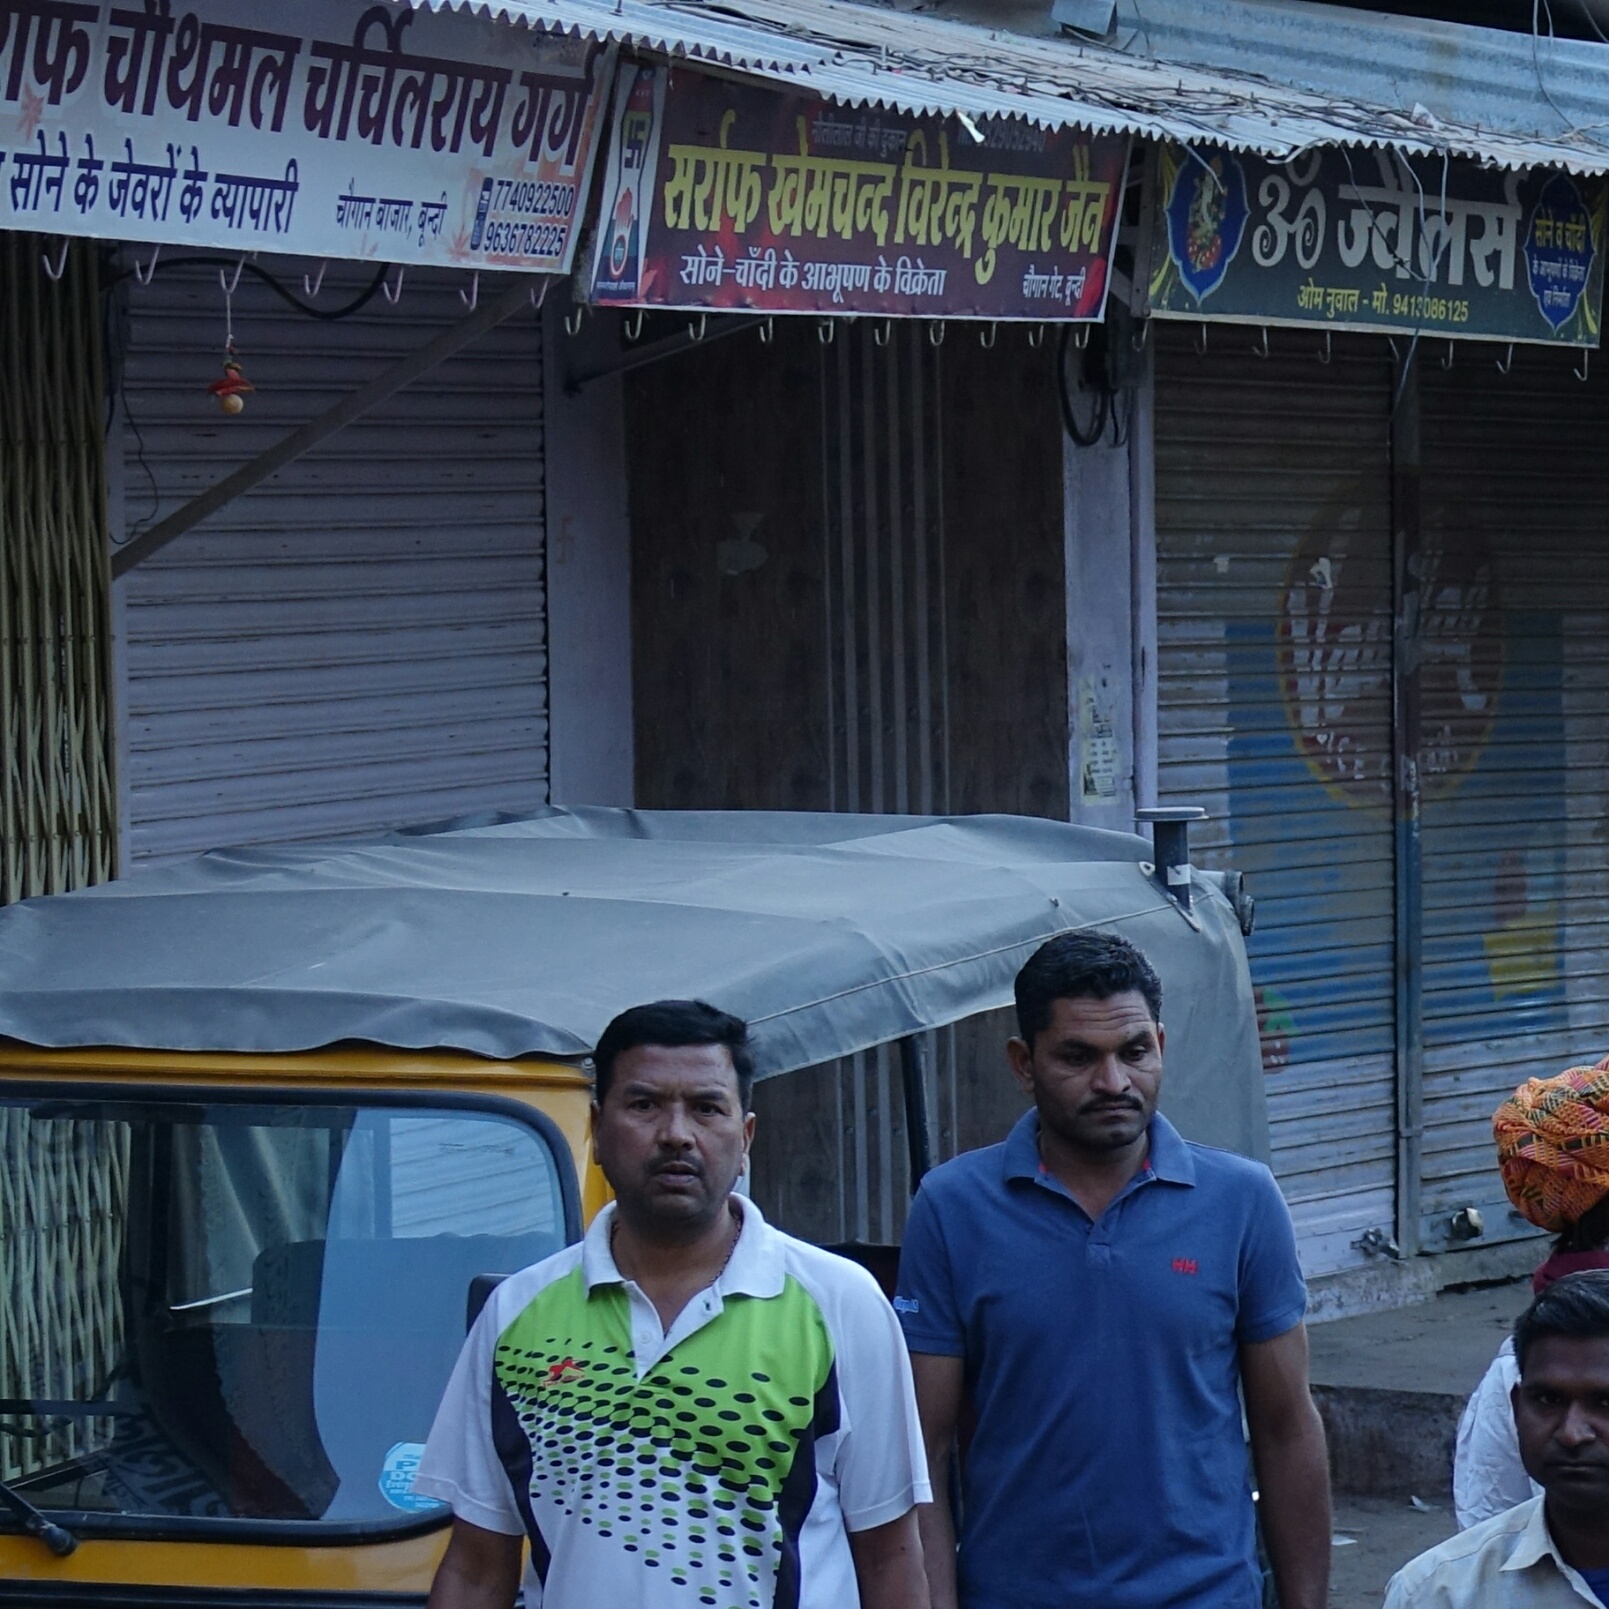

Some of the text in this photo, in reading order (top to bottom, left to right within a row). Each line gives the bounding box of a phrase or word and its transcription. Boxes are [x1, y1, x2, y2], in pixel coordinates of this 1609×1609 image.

[10, 129, 299, 234] सोने के जेवरों के व्यापारी
[492, 179, 576, 218] 7740922500
[975, 172, 1063, 286] कुमार
[1060, 144, 1111, 254] जैन
[779, 249, 800, 290] के
[874, 255, 894, 294] के
